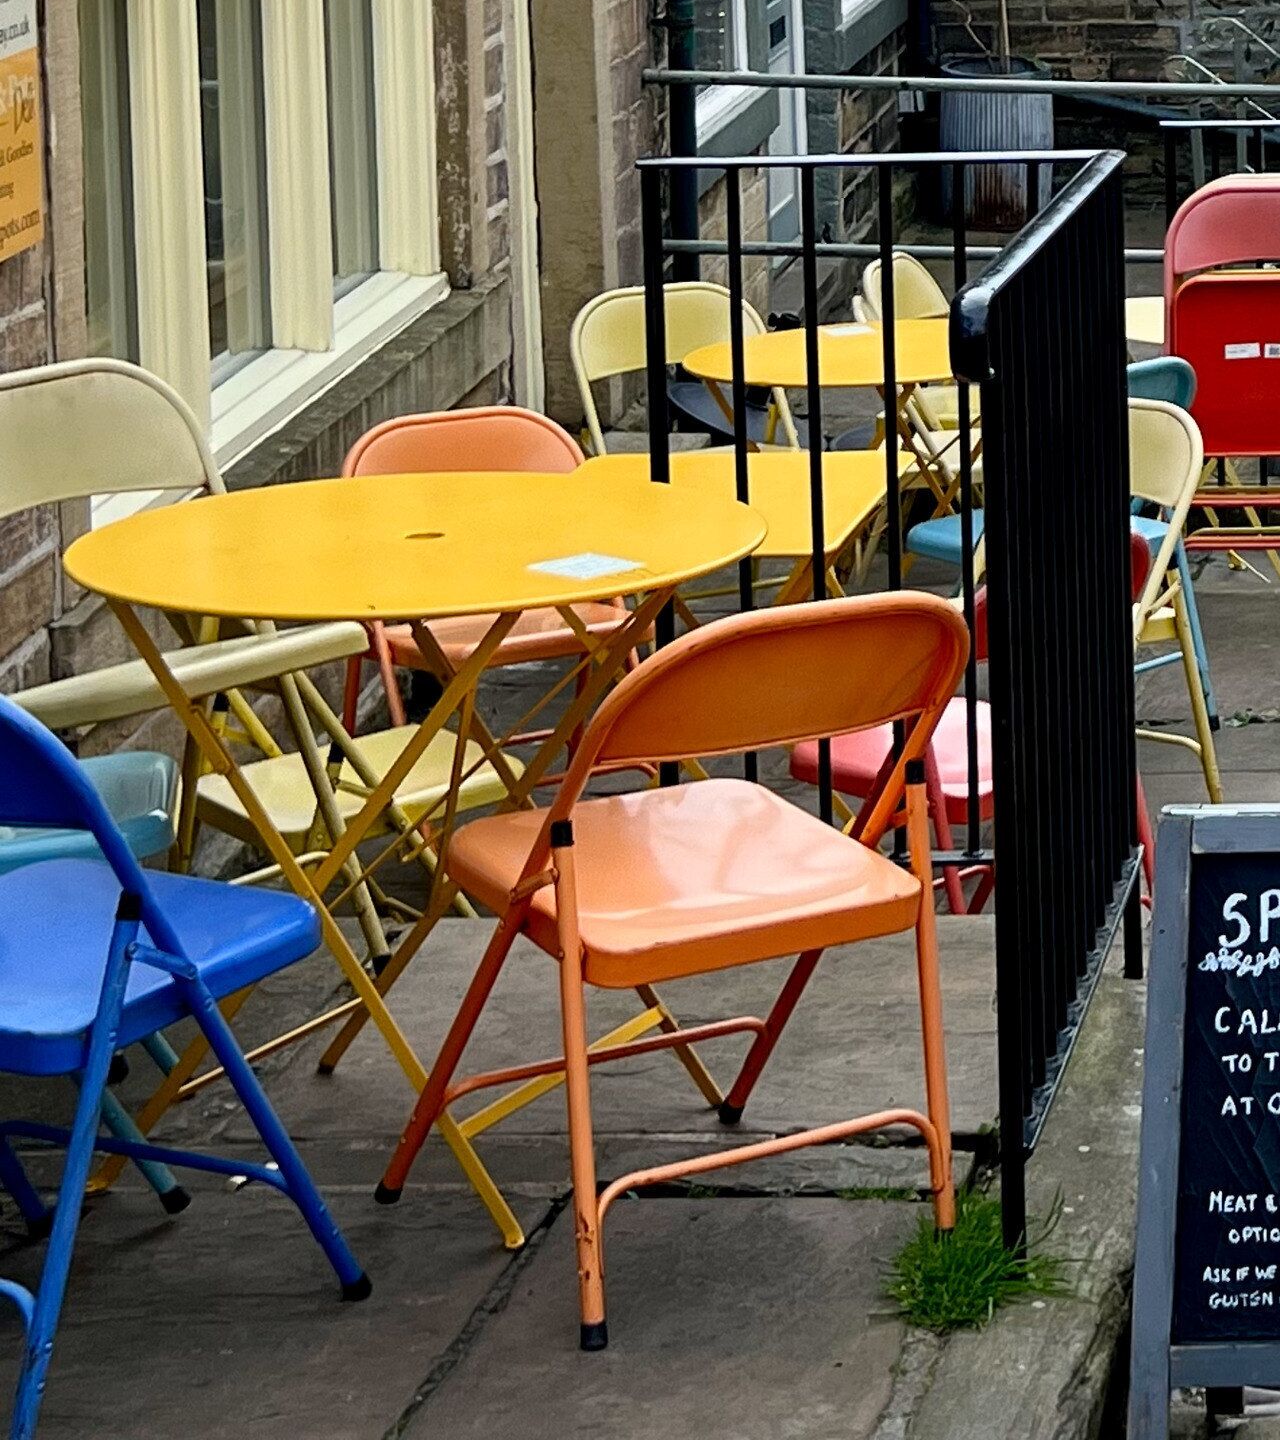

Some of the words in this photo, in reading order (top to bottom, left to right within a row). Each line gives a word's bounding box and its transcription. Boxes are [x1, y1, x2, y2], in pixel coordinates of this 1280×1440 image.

[1221, 1053, 1252, 1073] TO
[1221, 1095, 1254, 1116] AT
[1208, 1190, 1258, 1213] MEAT
[1202, 1266, 1231, 1283] ASK
[1236, 1266, 1250, 1282] IF
[1255, 1264, 1278, 1280] WE
